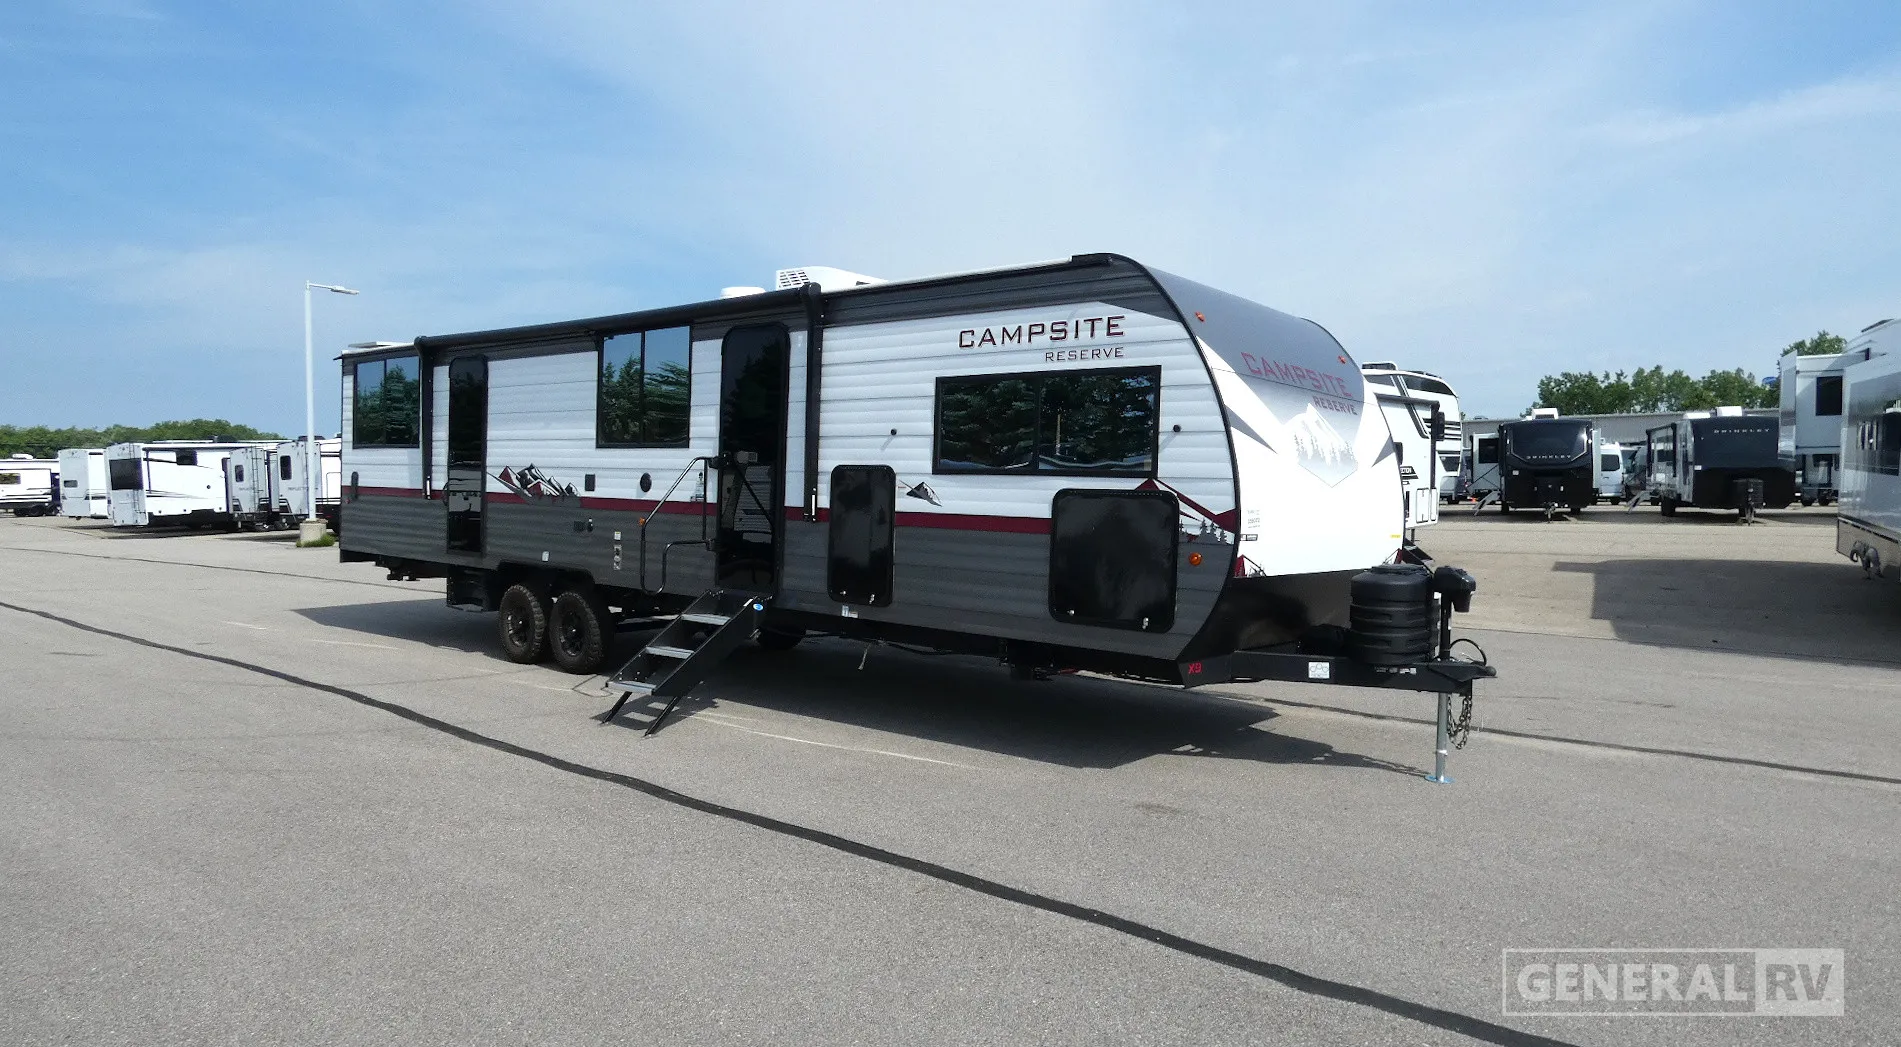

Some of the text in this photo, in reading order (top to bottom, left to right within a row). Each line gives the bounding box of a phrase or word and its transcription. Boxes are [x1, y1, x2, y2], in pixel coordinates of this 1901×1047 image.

[958, 315, 1126, 349] CAMPSITE
[1045, 346, 1124, 362] RESERVE
[1241, 352, 1352, 397] CAMPSITE
[1312, 395, 1358, 416] RESERVE
